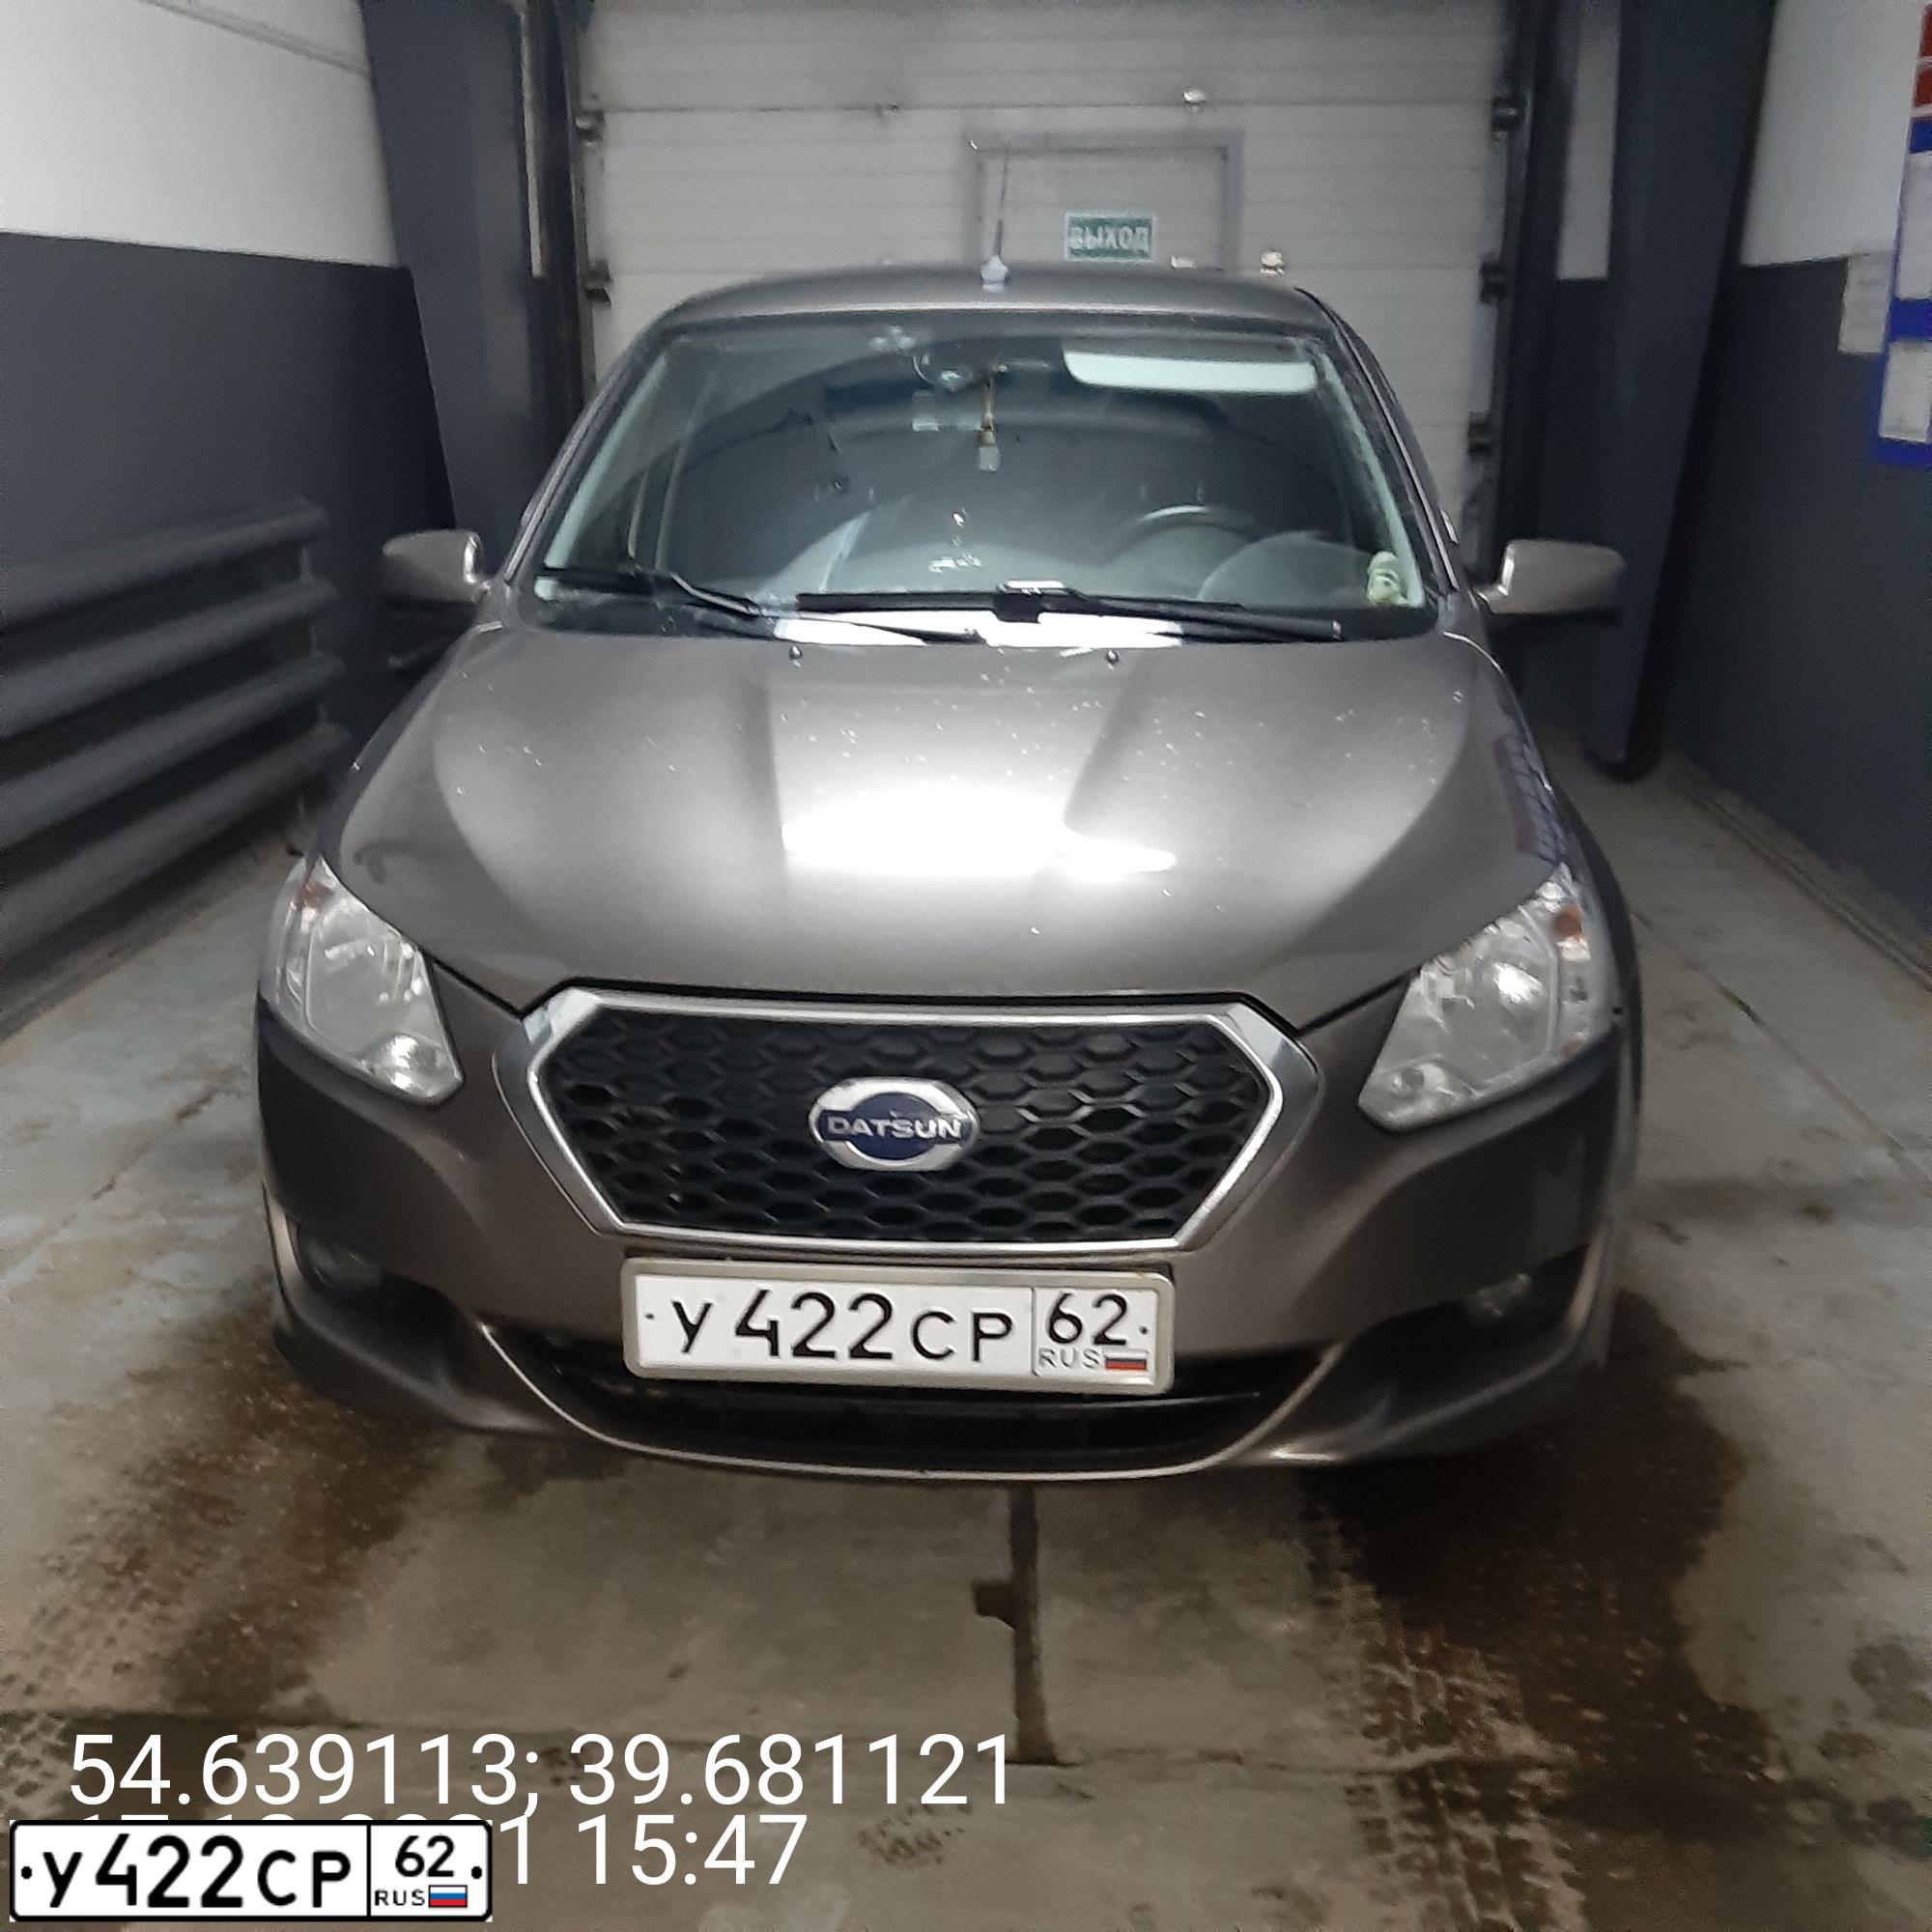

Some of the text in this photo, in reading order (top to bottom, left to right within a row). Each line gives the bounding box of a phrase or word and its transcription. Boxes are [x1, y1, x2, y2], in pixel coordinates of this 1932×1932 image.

[1068, 225, 1150, 251] ВЫХОД
[828, 1116, 962, 1139] DATSUN
[1048, 1293, 1127, 1346] 62
[1038, 1349, 1100, 1369] RUS
